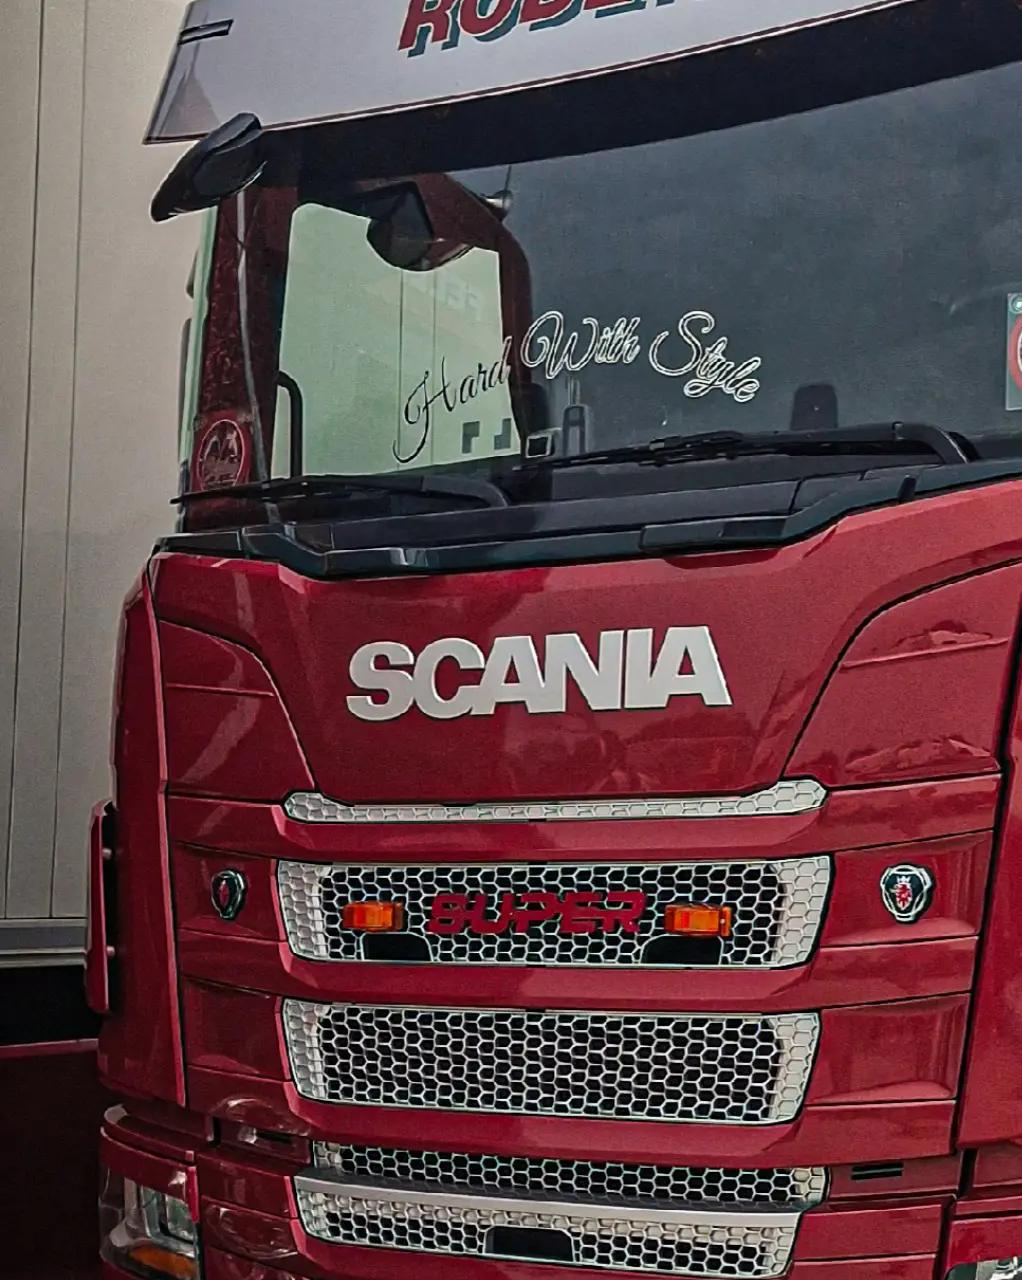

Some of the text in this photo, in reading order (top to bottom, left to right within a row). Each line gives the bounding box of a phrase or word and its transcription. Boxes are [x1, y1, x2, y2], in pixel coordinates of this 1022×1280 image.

[392, 310, 762, 463] Hard With Style
[346, 625, 732, 721] SCANIA
[427, 890, 646, 934] SUPER
